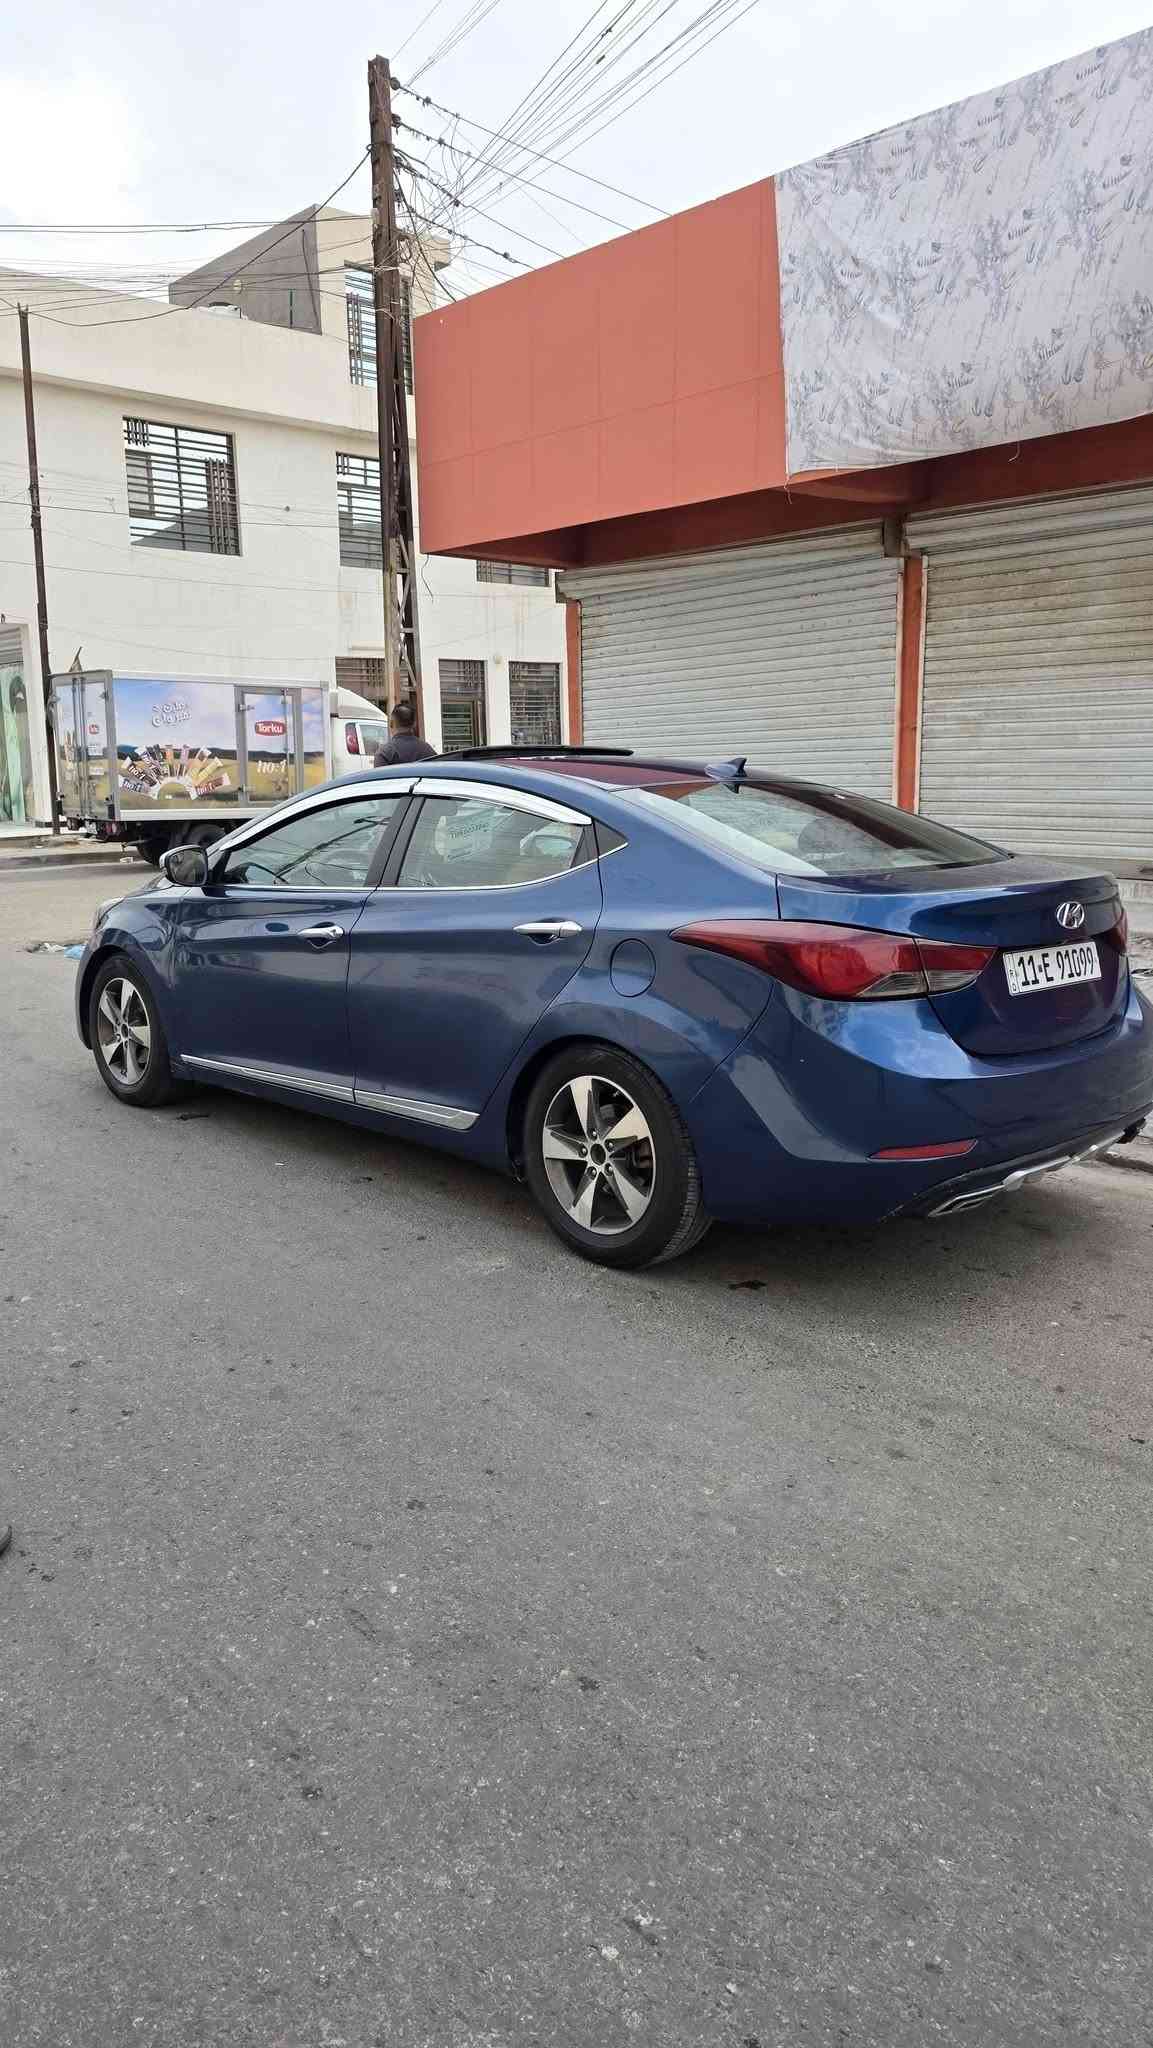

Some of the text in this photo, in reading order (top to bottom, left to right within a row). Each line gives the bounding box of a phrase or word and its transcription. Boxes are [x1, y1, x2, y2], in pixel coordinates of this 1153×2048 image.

[258, 724, 283, 733] Torku
[1018, 953, 1054, 986] 11-E
[1056, 947, 1093, 979] 91099
